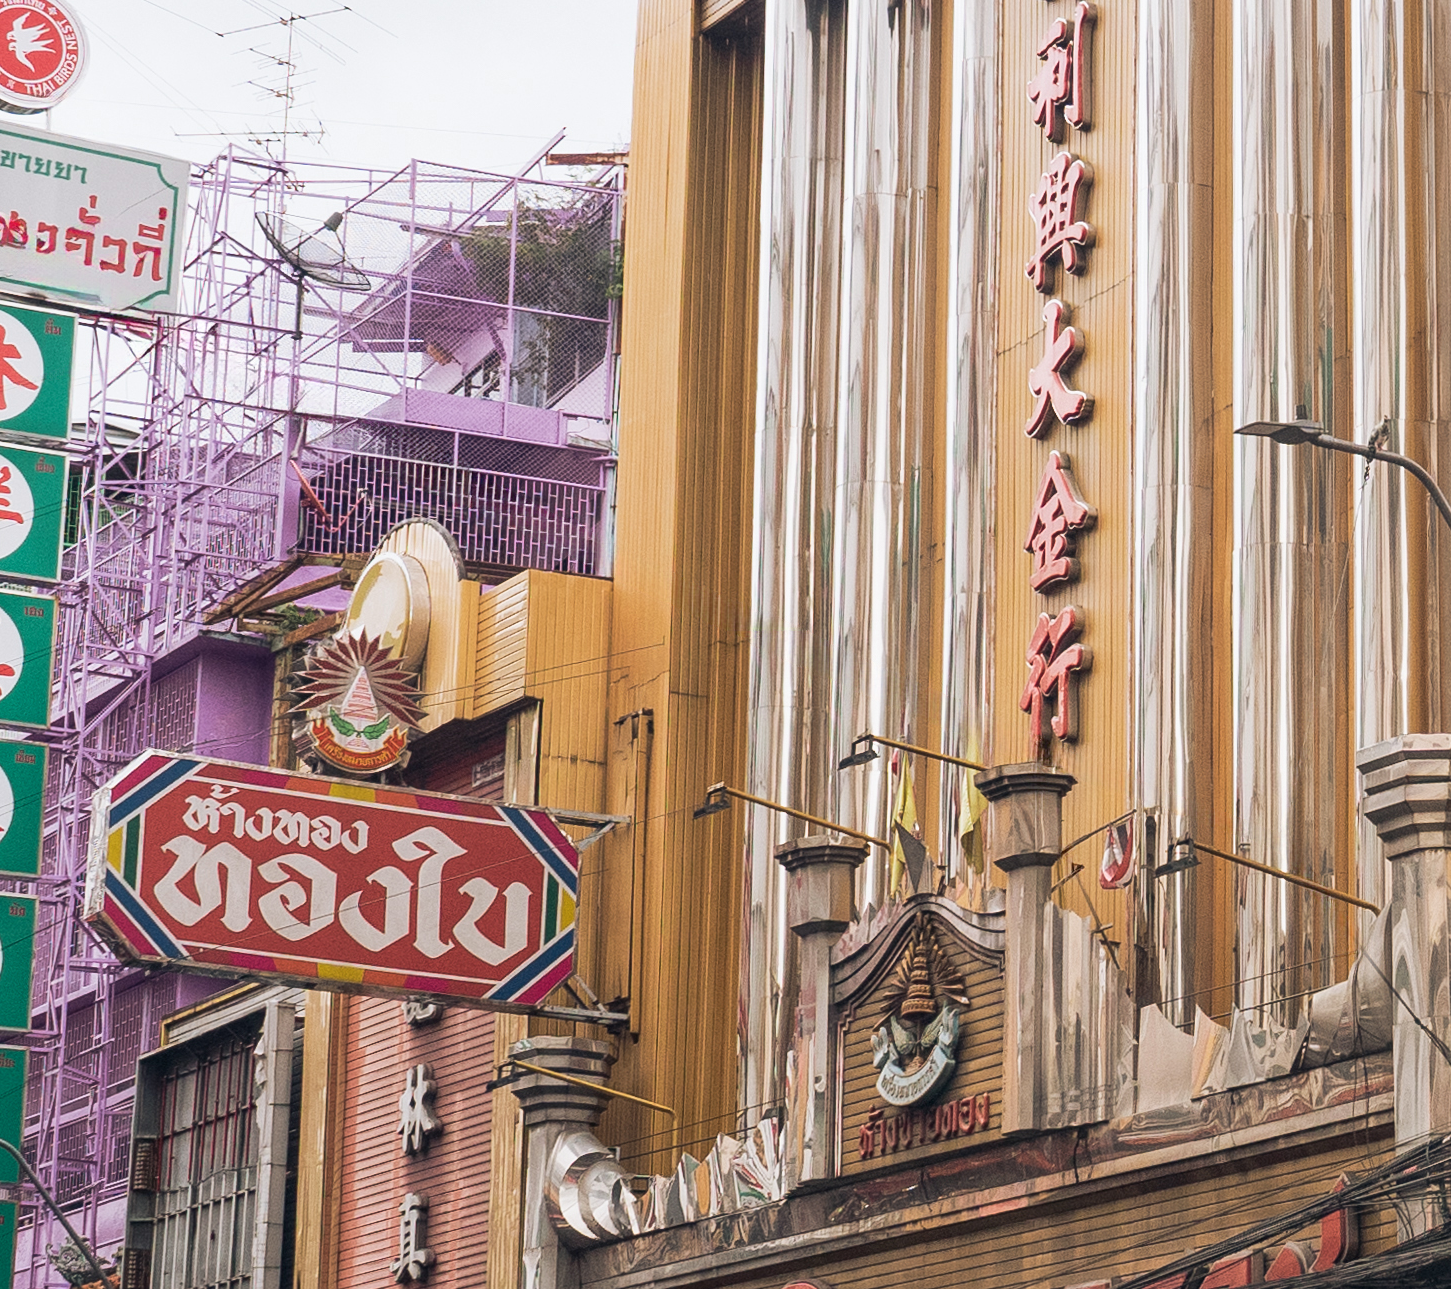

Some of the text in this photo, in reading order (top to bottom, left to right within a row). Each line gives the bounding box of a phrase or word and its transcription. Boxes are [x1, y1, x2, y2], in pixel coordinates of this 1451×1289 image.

[24, 19, 78, 97] THAI BIRDS NEST
[182, 783, 370, 856] ห้างทอง
[153, 825, 532, 967] ทองใบ
[858, 1092, 991, 1160] ห้างขายทอง
